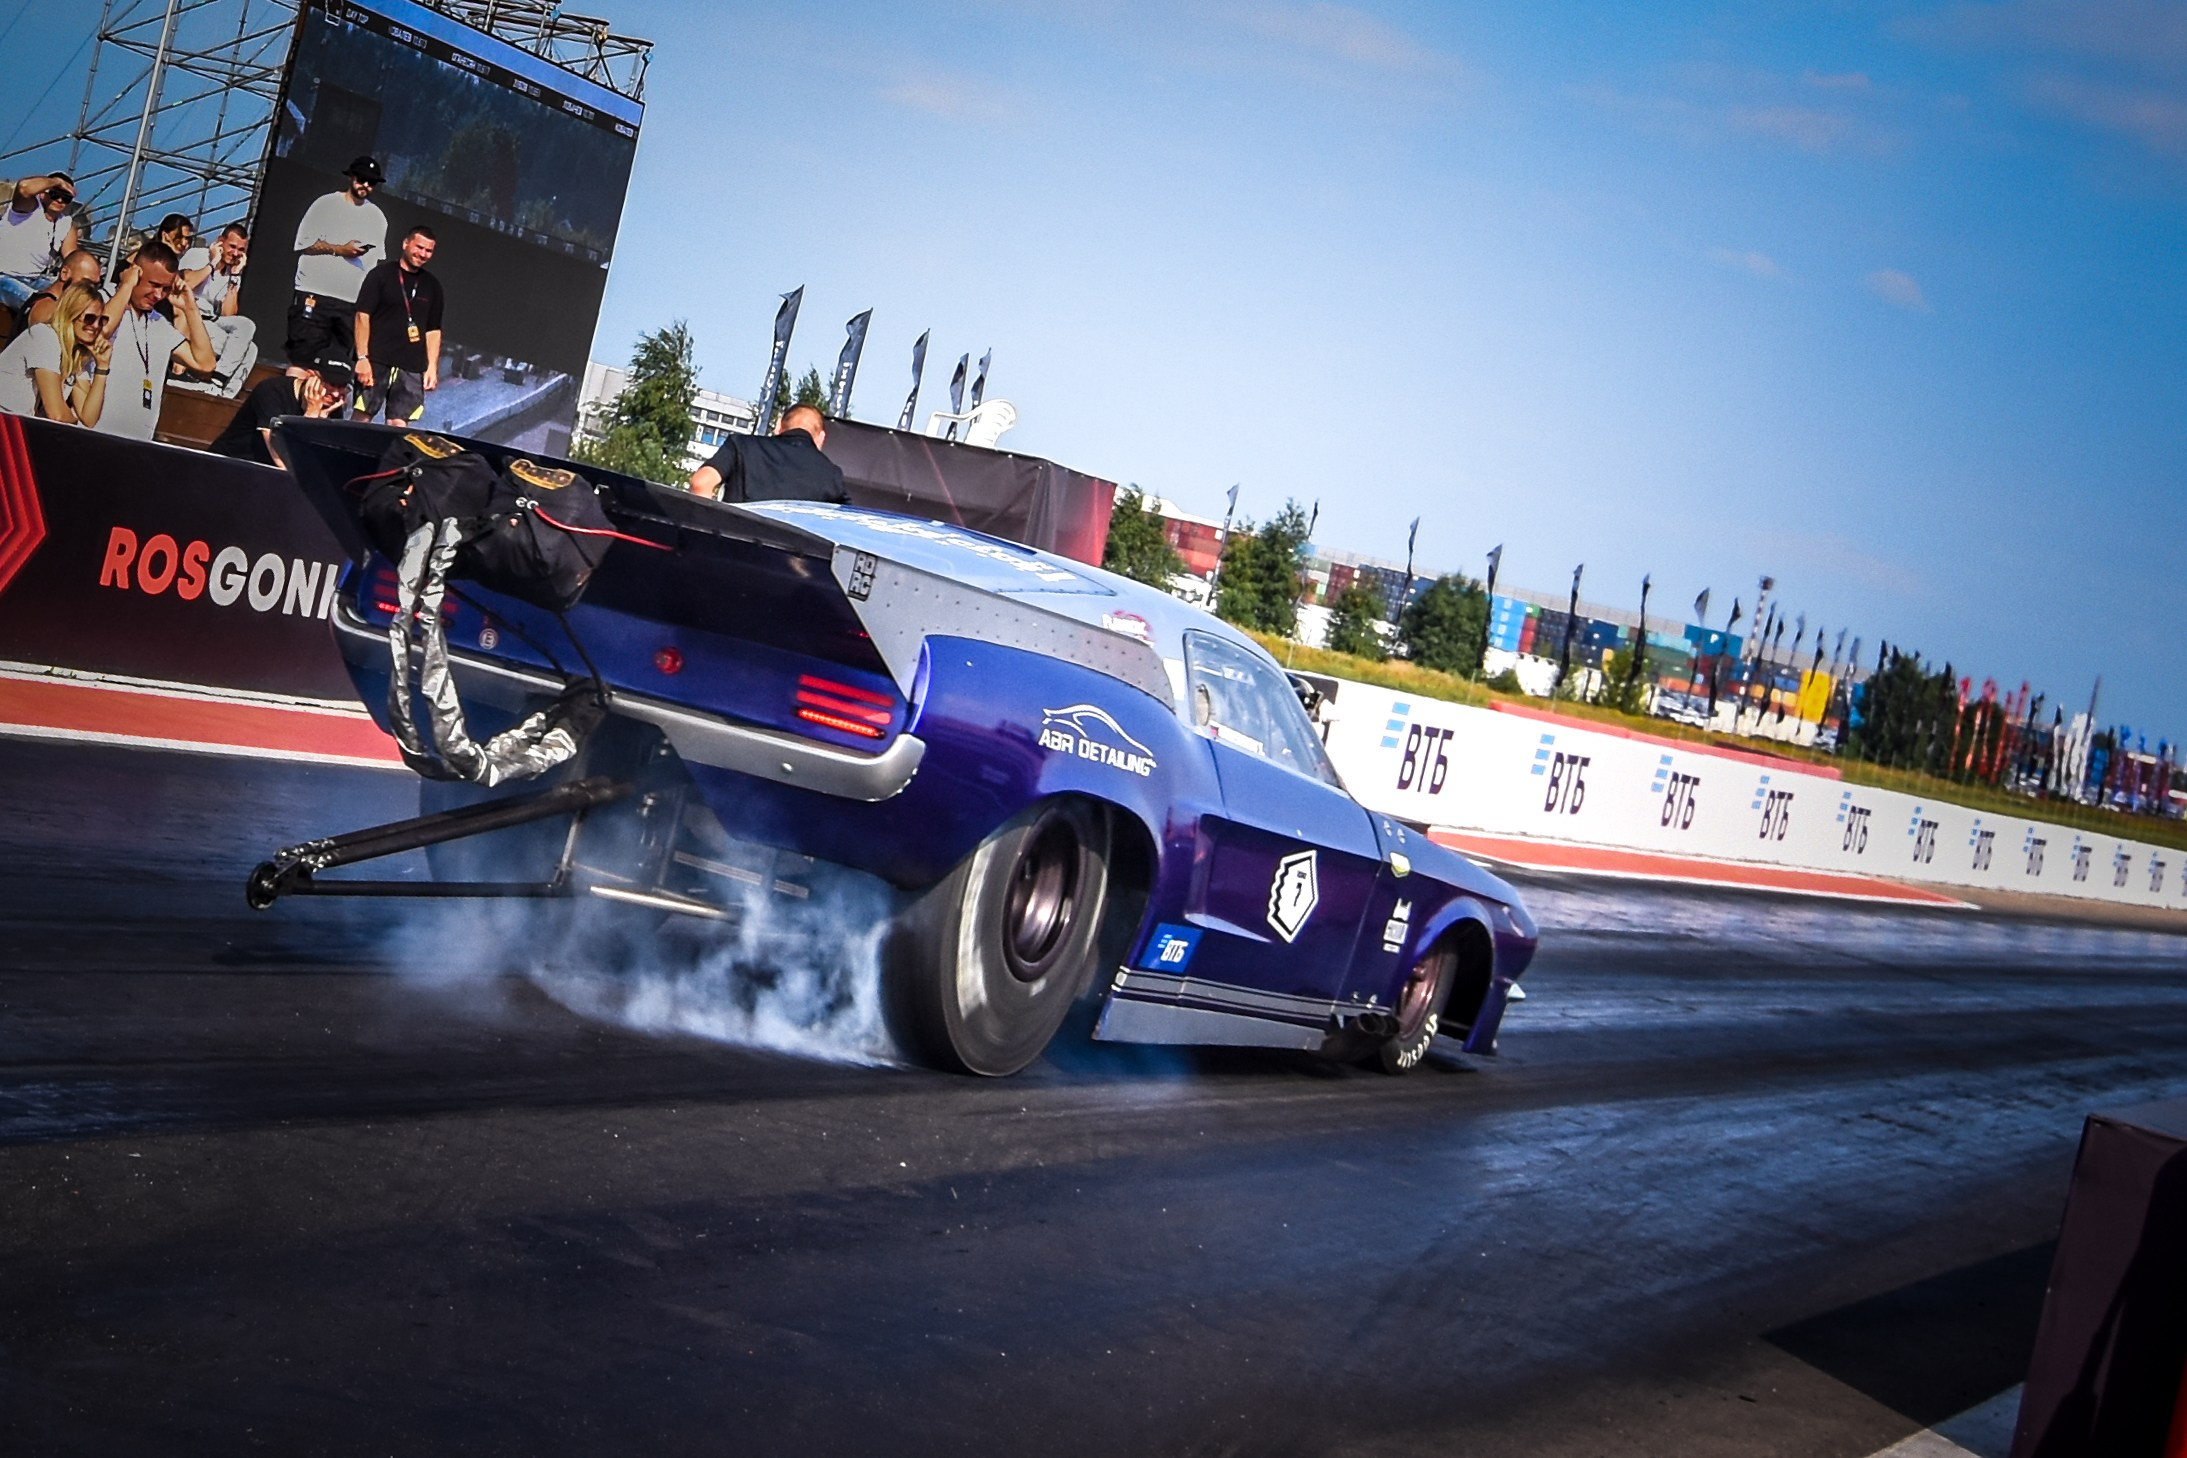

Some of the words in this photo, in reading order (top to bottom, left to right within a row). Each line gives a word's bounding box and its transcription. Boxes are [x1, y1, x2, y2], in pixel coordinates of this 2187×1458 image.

[1038, 728, 1075, 754] ABR
[1078, 738, 1151, 777] DETAILING
[1397, 724, 1454, 796] ВТБ
[1544, 752, 1591, 815] ВТБ
[1661, 772, 1700, 830] ВТБ
[1759, 790, 1794, 841] ВТБ
[1843, 806, 1872, 854] ВТБ
[1914, 820, 1939, 863] ВТБ
[1160, 938, 1189, 964] ВТБ
